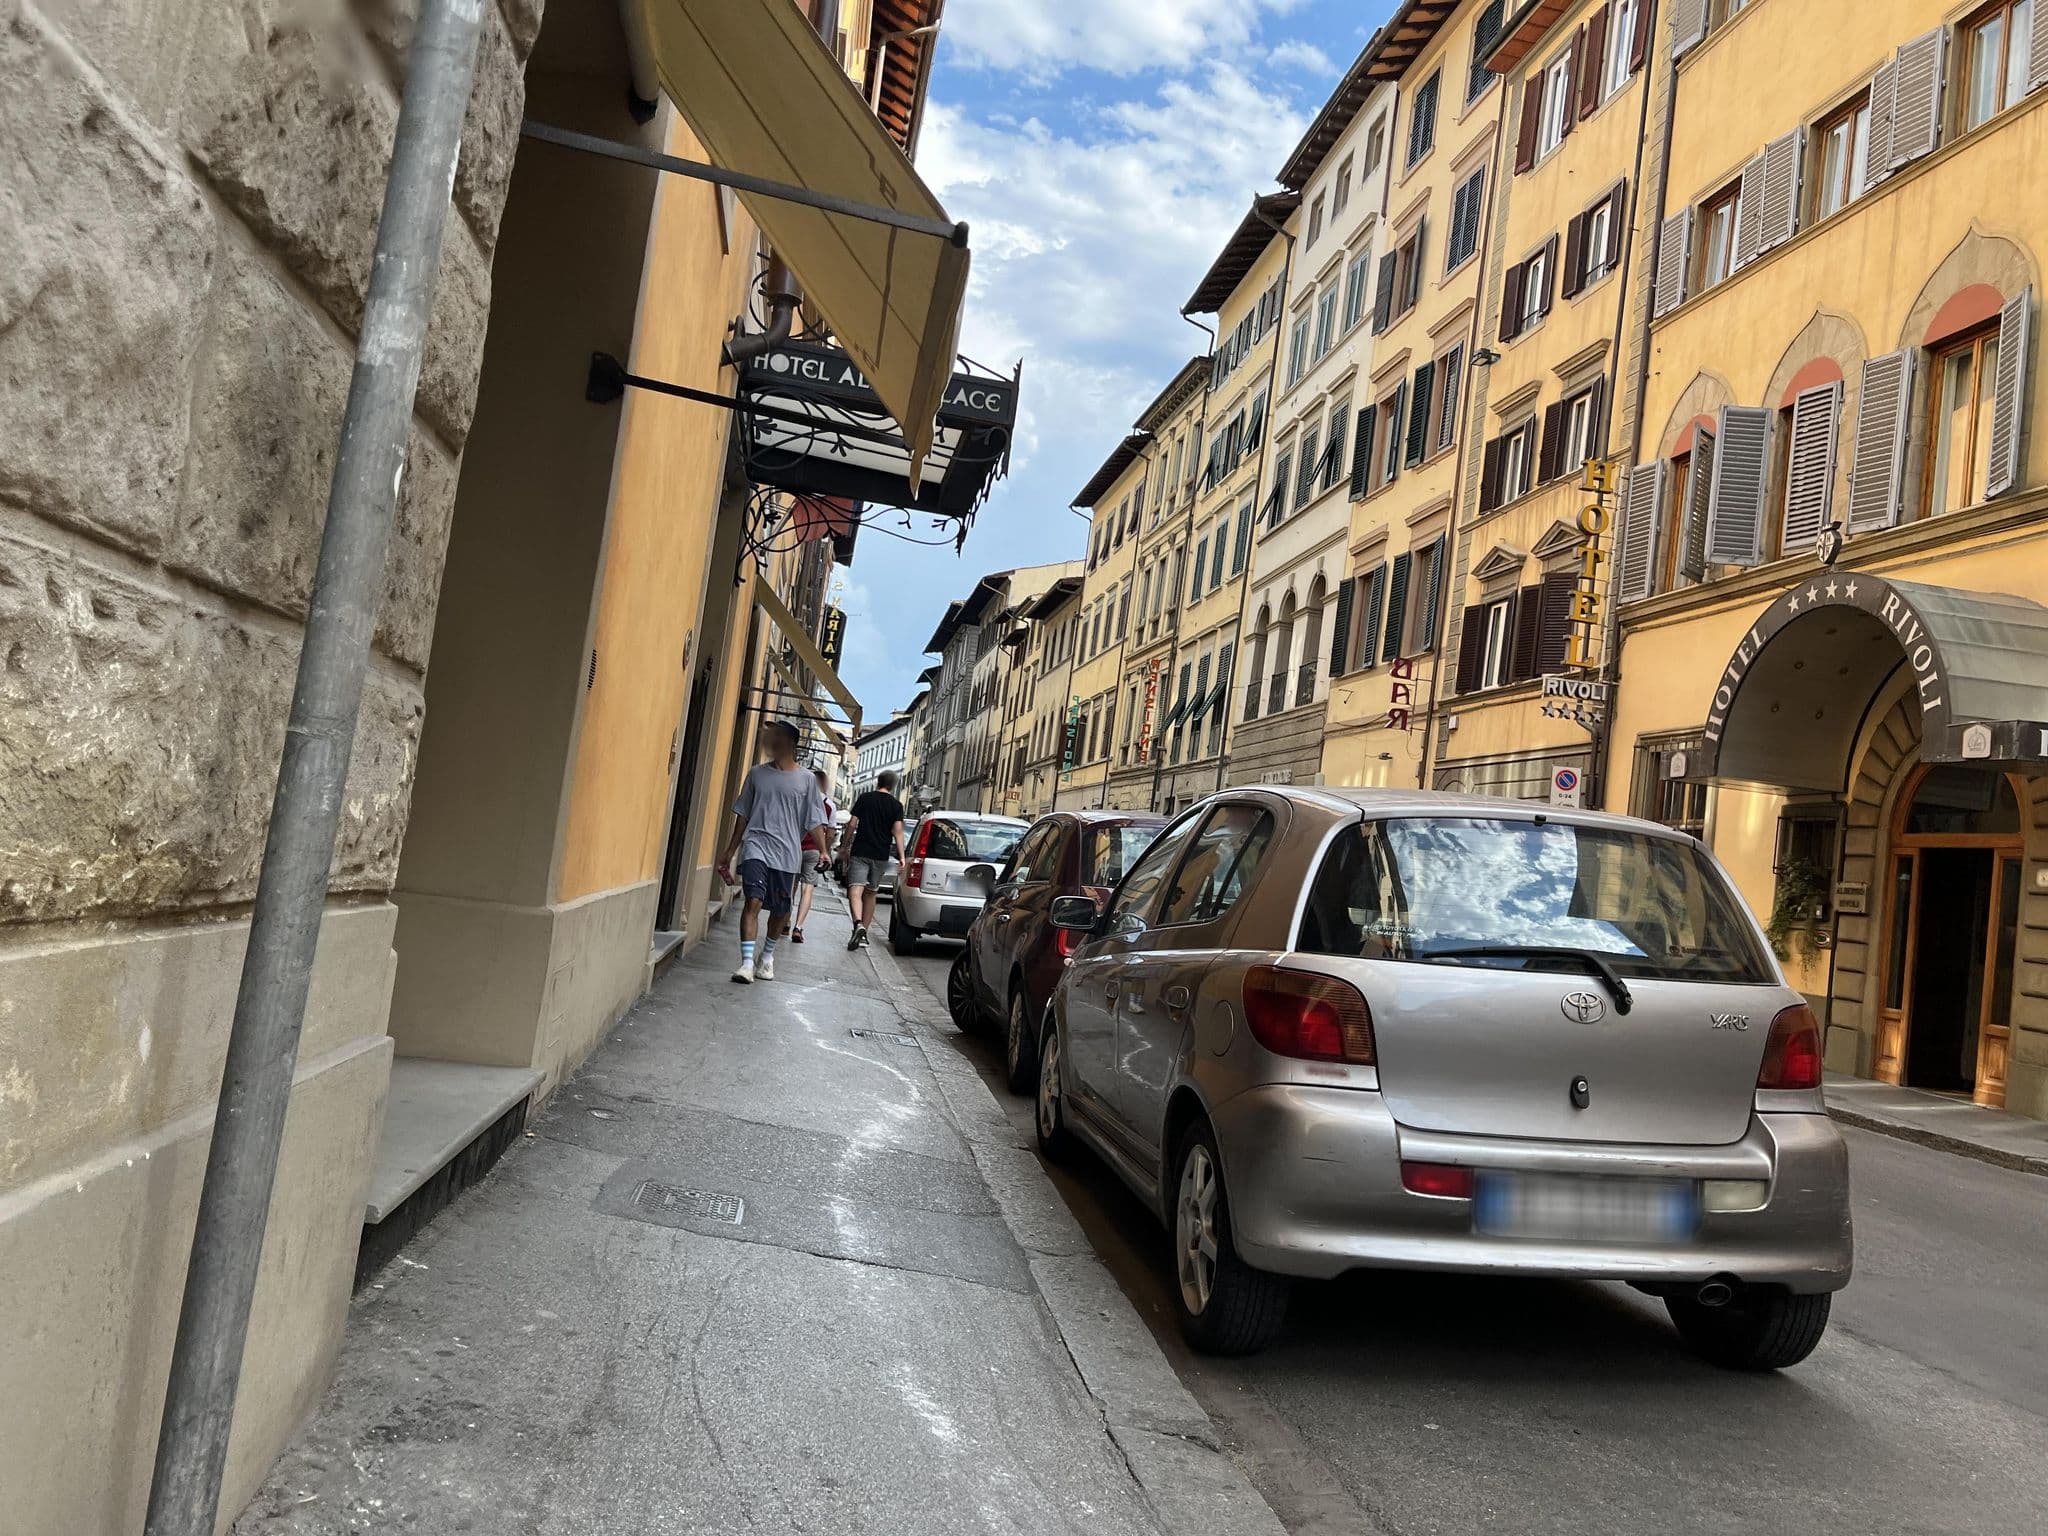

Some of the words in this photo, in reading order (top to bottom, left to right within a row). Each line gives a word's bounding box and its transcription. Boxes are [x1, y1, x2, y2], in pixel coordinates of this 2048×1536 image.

[753, 353, 829, 381] HOTEL
[838, 367, 871, 389] AL
[1564, 459, 1614, 668] HOTEL
[1546, 680, 1607, 700] RIVOLI
[1705, 627, 1767, 742] HOTEL
[1880, 592, 1942, 713] RIVOLI
